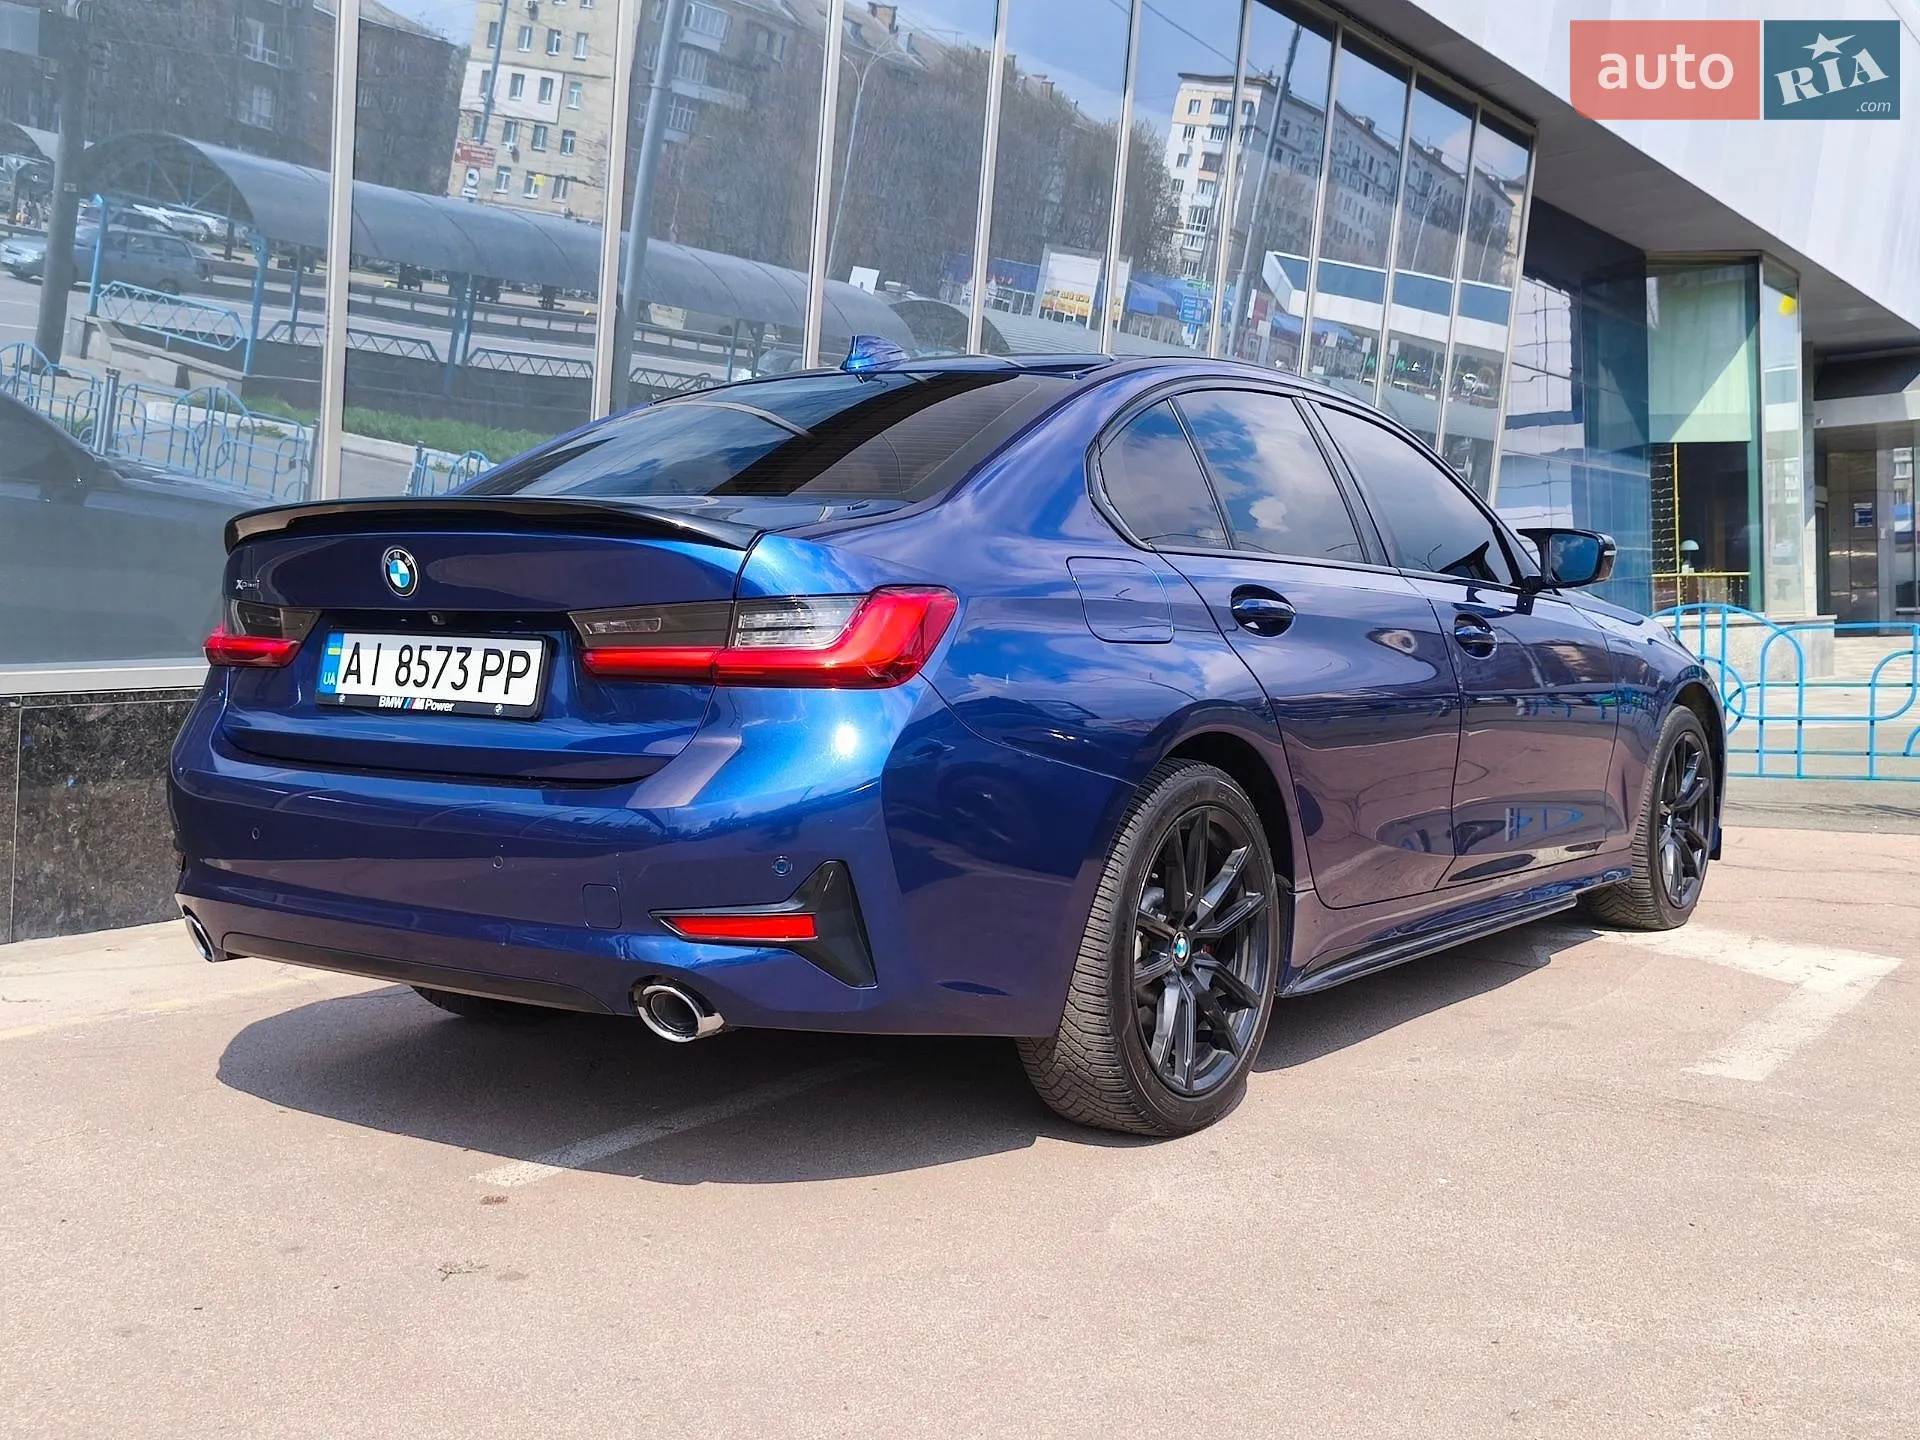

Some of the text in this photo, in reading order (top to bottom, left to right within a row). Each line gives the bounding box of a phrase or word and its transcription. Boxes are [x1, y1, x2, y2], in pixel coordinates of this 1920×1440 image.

[342, 641, 531, 695] AI 8573 PP
[323, 671, 336, 686] UA
[378, 695, 404, 709] BMW
[425, 698, 455, 712] Power
